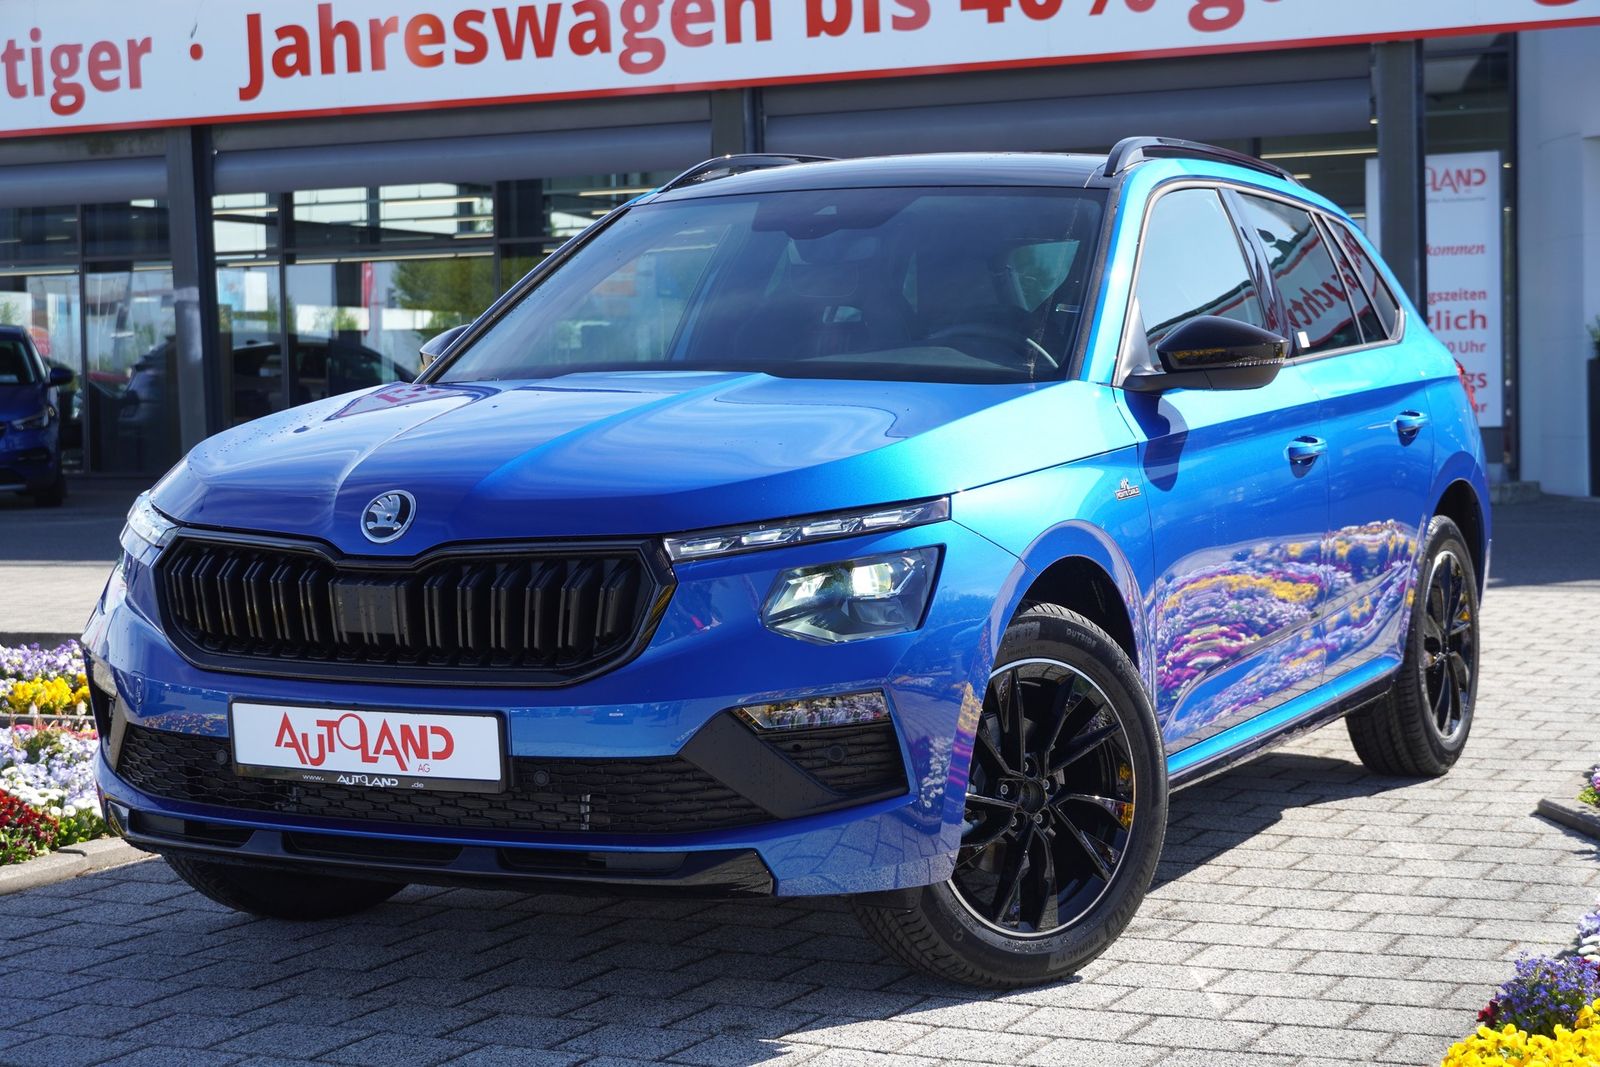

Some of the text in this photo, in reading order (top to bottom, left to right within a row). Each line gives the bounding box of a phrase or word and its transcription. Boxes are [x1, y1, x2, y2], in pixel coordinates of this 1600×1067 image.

[238, 0, 773, 101] Jahreswagen
[1459, 340, 1487, 354] Uhr
[417, 763, 431, 773] AG
